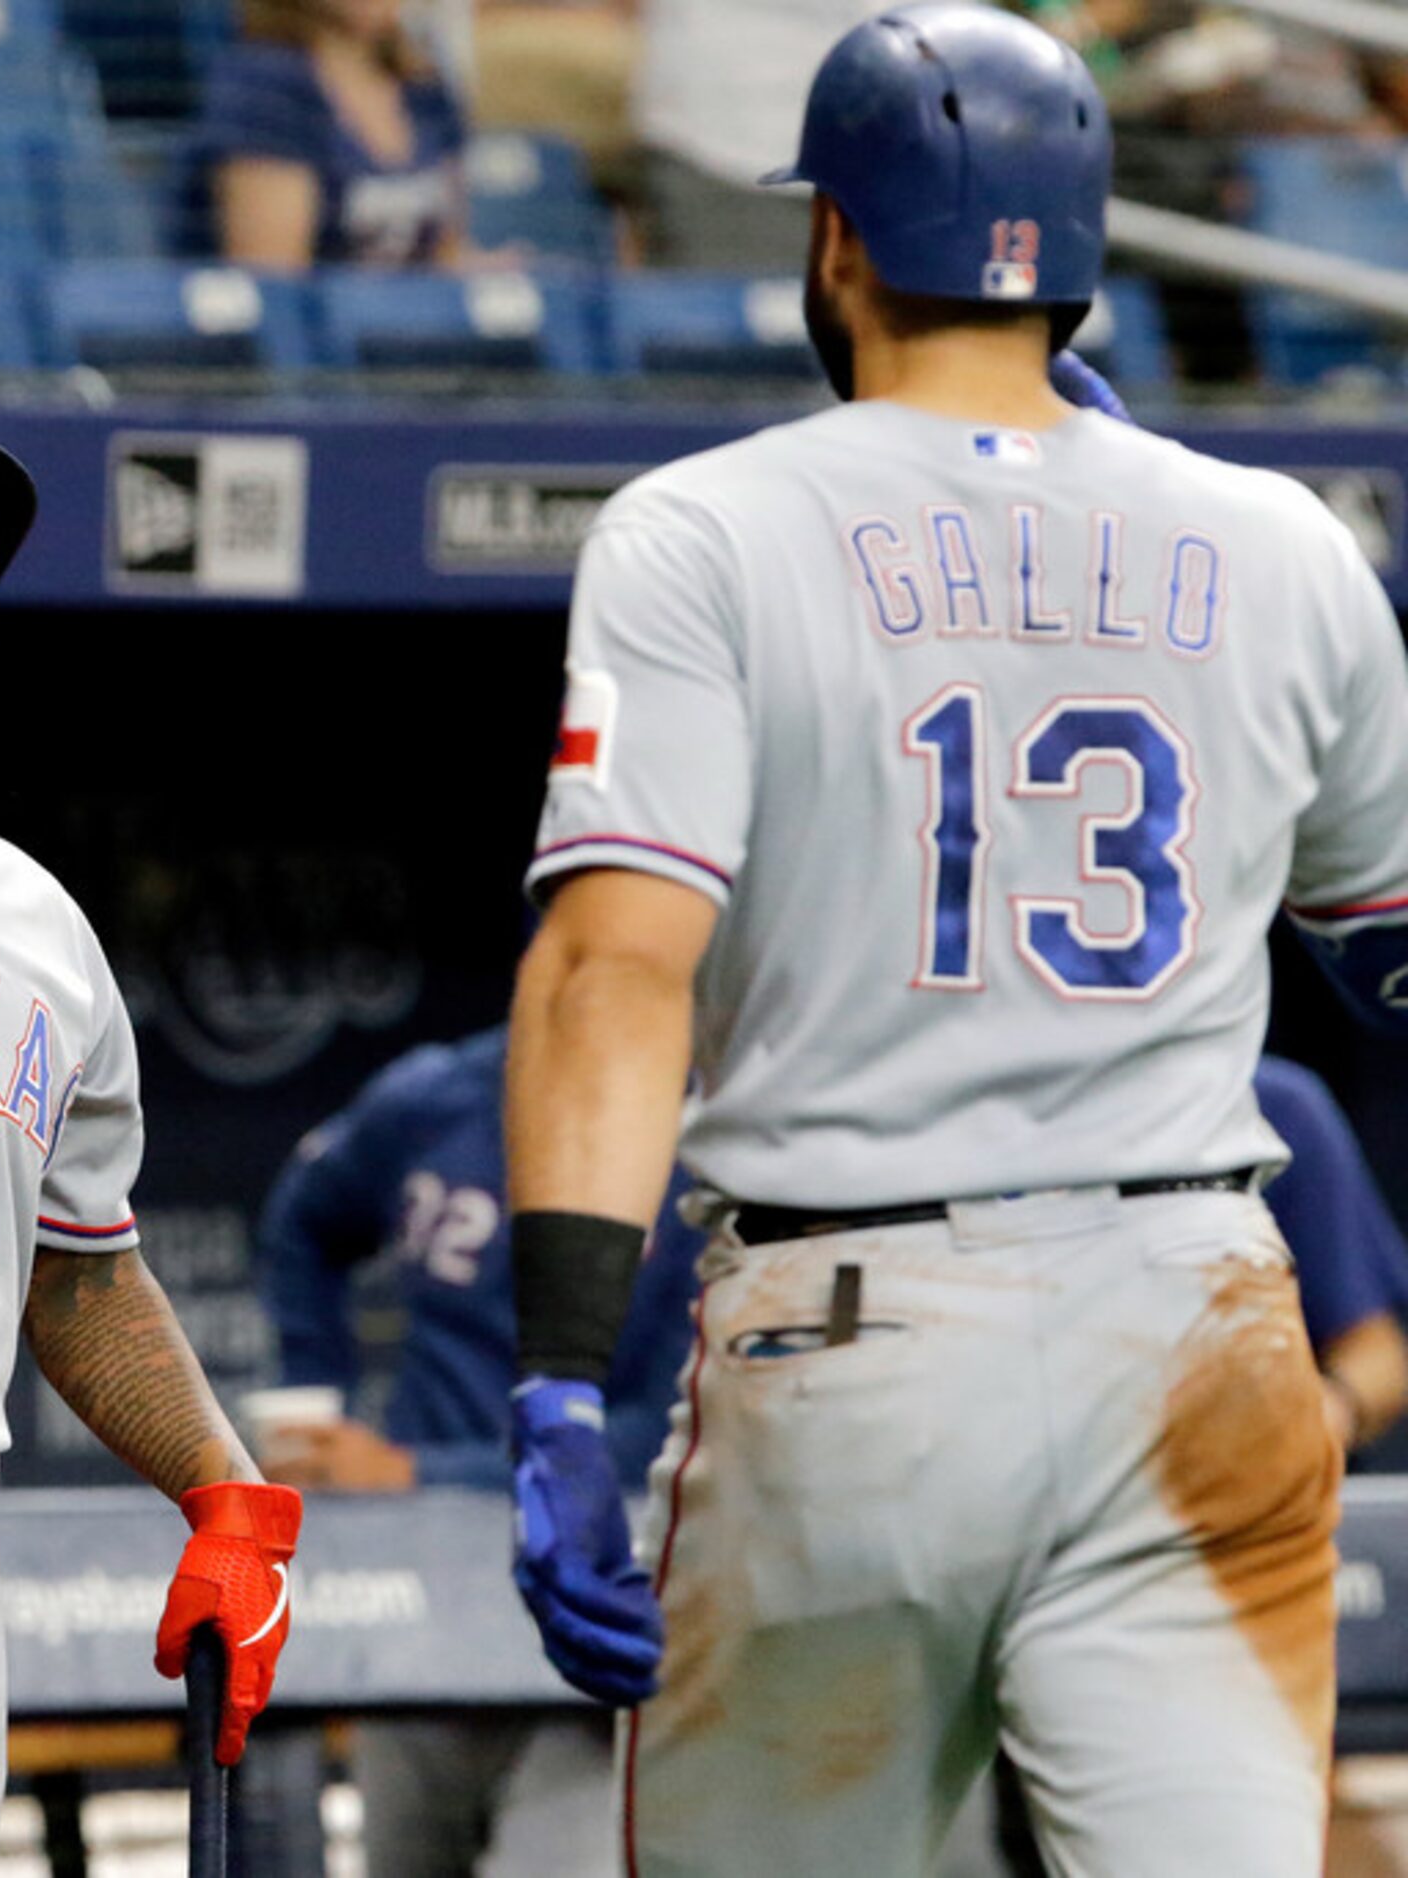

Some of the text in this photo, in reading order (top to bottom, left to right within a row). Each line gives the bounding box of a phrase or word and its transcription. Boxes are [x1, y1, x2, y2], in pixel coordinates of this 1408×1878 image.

[990, 217, 1040, 262] 13
[841, 504, 1226, 662] GALLO
[900, 681, 1204, 1003] 13
